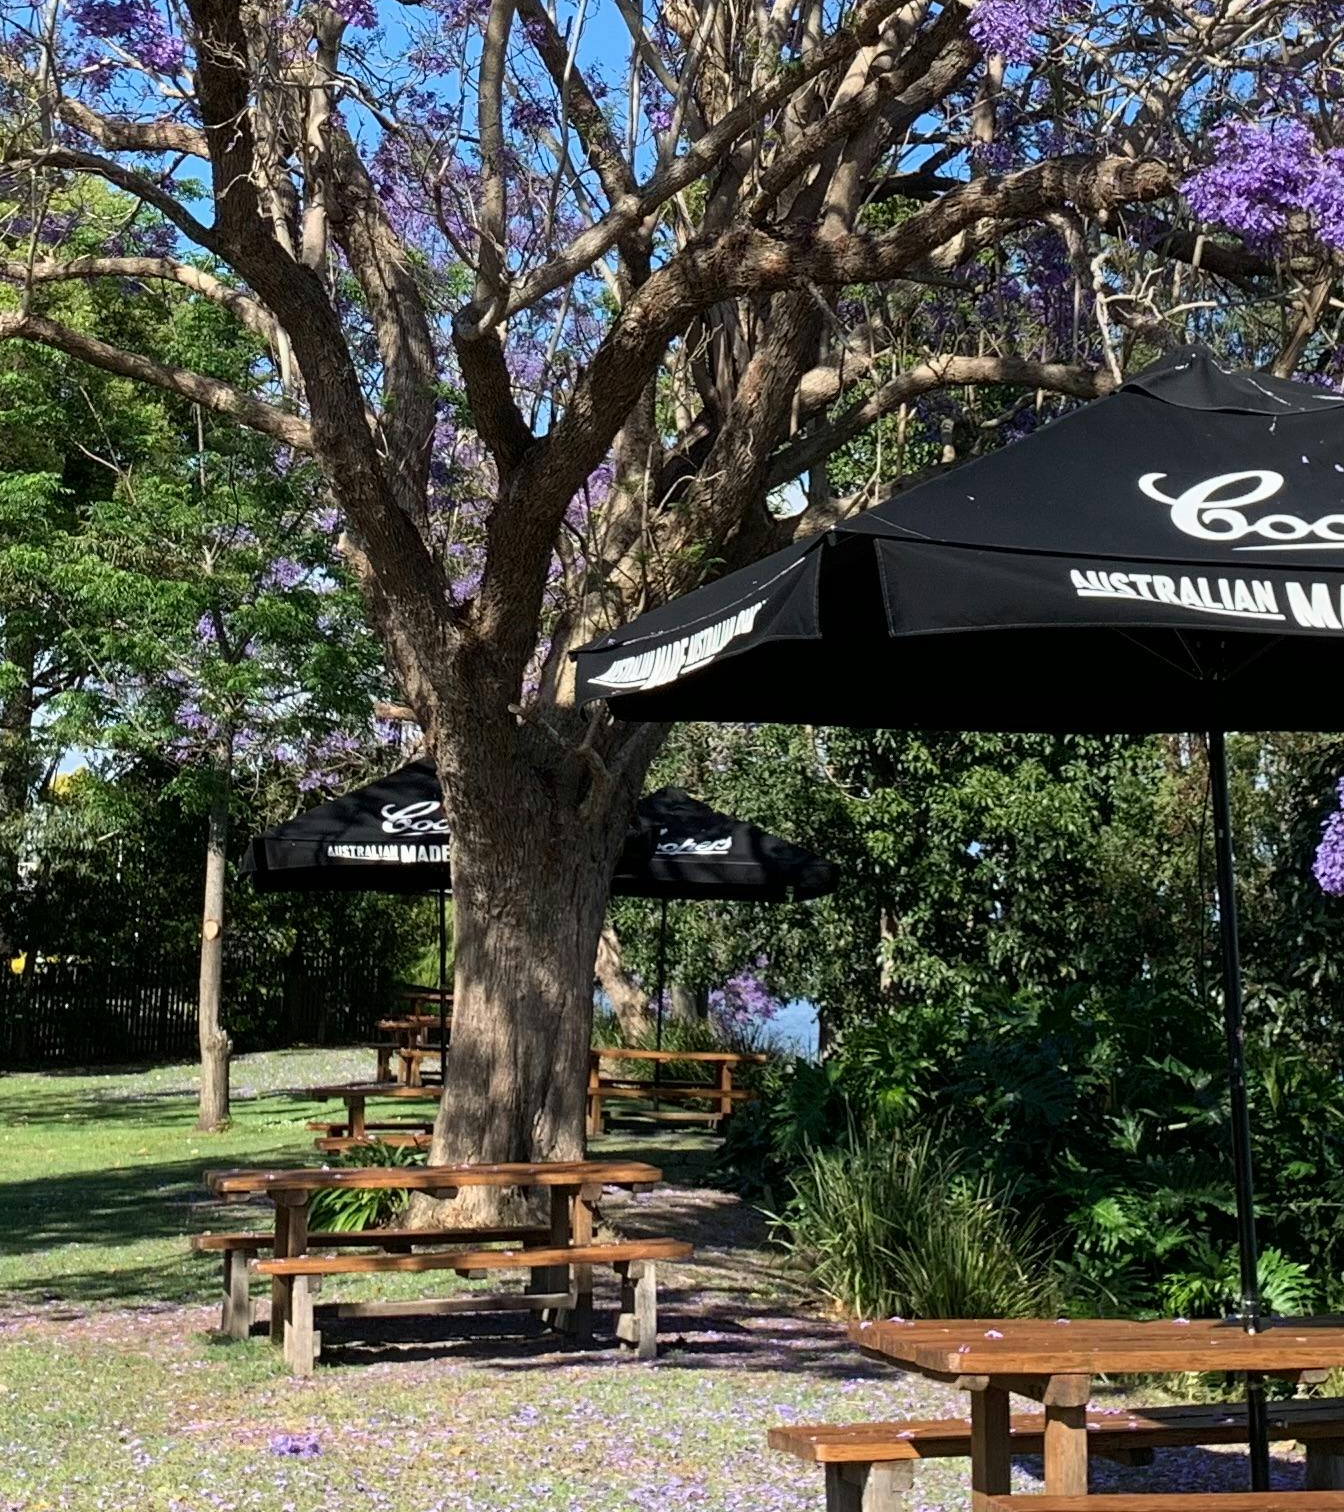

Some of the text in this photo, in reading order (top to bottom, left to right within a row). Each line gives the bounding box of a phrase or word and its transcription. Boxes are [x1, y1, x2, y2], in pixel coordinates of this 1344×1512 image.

[1070, 569, 1282, 617] AUSTRALIAN
[327, 844, 399, 859] AUSTRALIAN
[657, 829, 732, 854] opers
